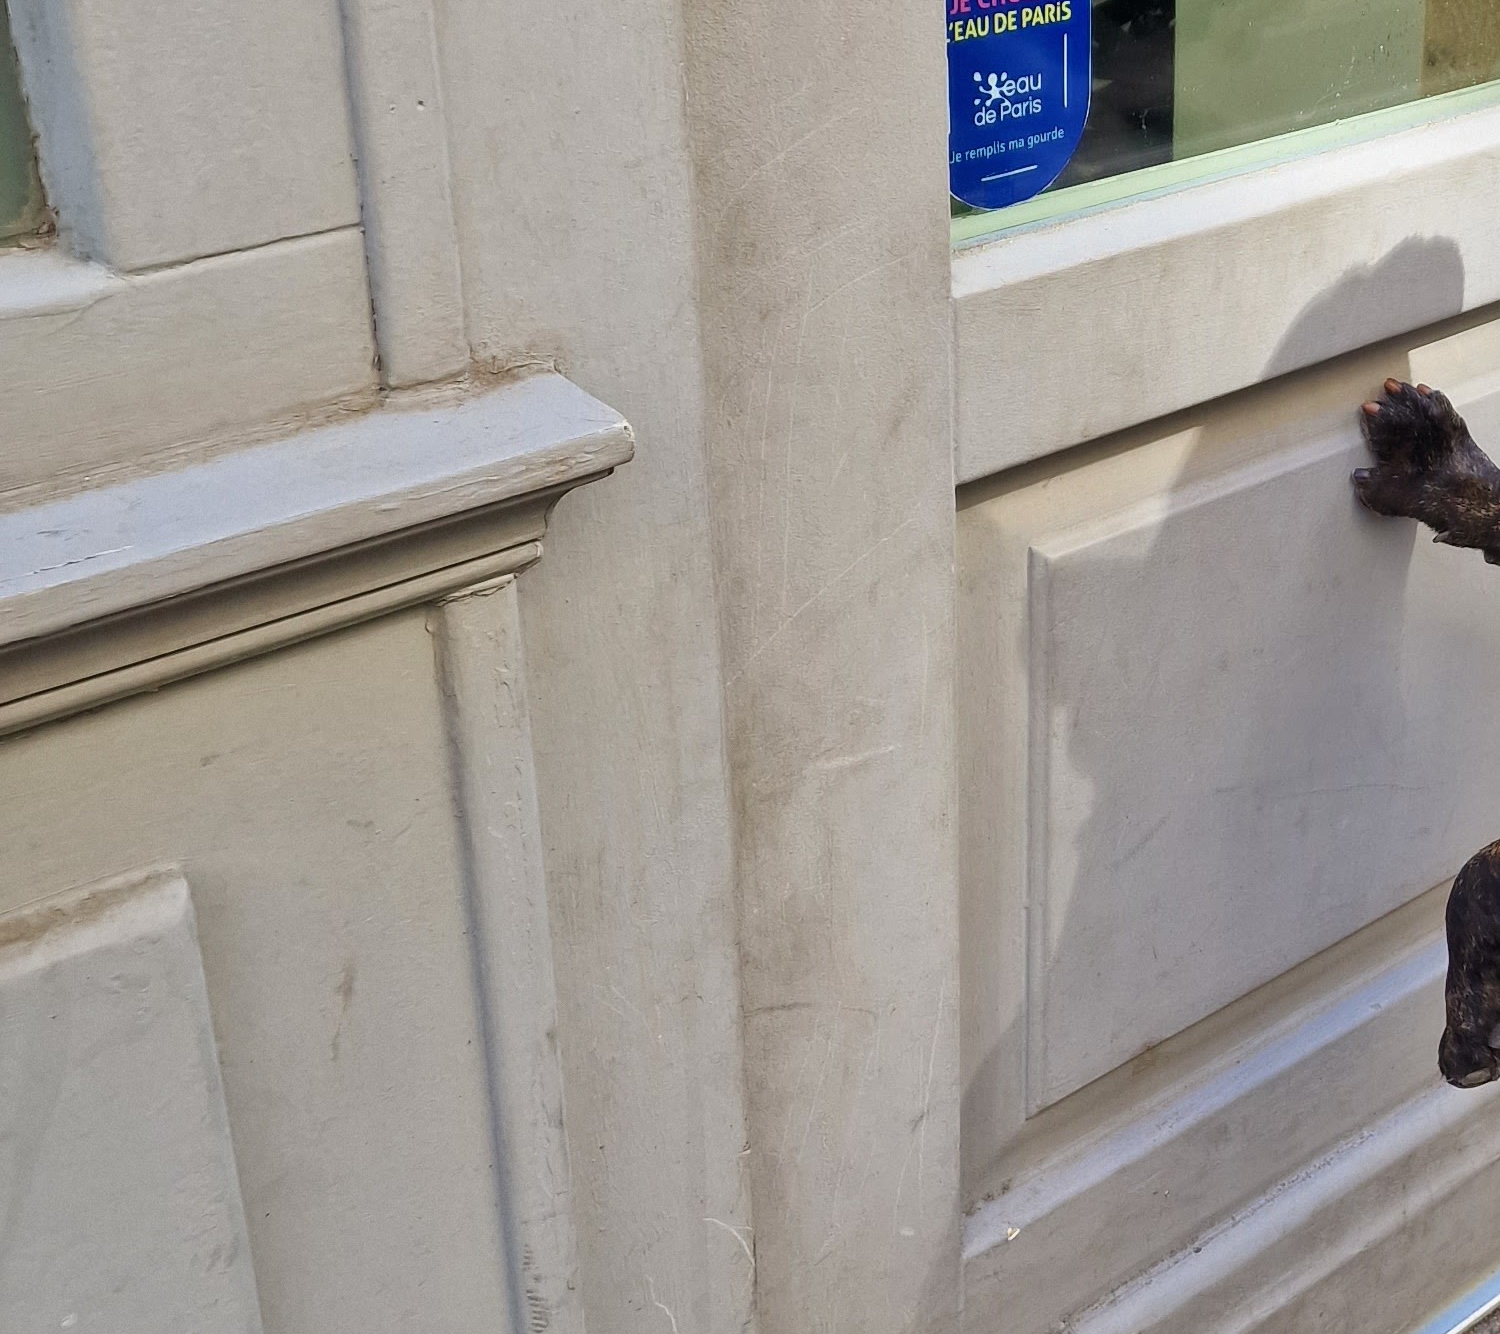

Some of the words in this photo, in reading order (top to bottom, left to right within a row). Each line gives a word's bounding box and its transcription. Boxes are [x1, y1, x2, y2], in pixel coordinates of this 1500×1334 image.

[946, 14, 990, 44] 'EAU
[993, 10, 1018, 34] DE
[974, 106, 997, 126] de
[1000, 96, 1042, 122] Paris
[965, 140, 1006, 160] remplis
[1008, 138, 1025, 150] ma
[1027, 126, 1065, 149] gourde
